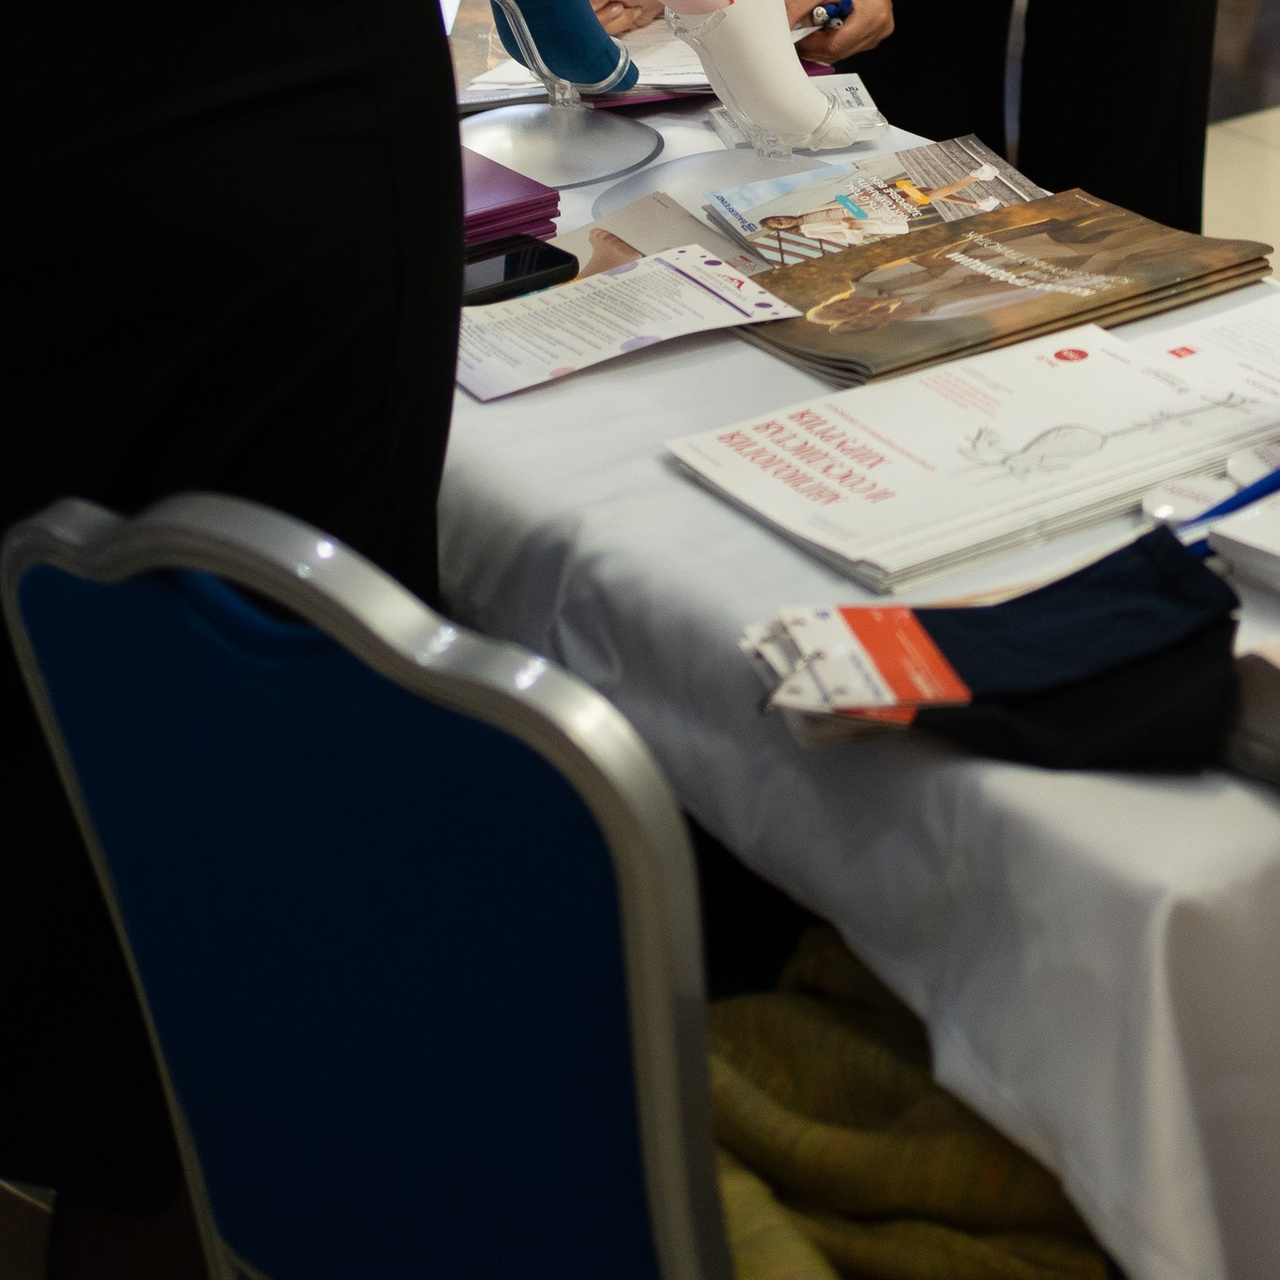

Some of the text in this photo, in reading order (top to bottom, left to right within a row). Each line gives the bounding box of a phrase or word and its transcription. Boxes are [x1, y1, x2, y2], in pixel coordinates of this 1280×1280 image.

[858, 178, 897, 210] СОХРАНИТЬ
[870, 176, 888, 189] ВЕН
[715, 195, 748, 227] BAUERFEIND
[883, 188, 923, 217] ЗДОРОВЬЕ
[787, 408, 892, 470] ХИРУРГИЯ
[717, 429, 848, 505] АНГИОЛОГИЯ
